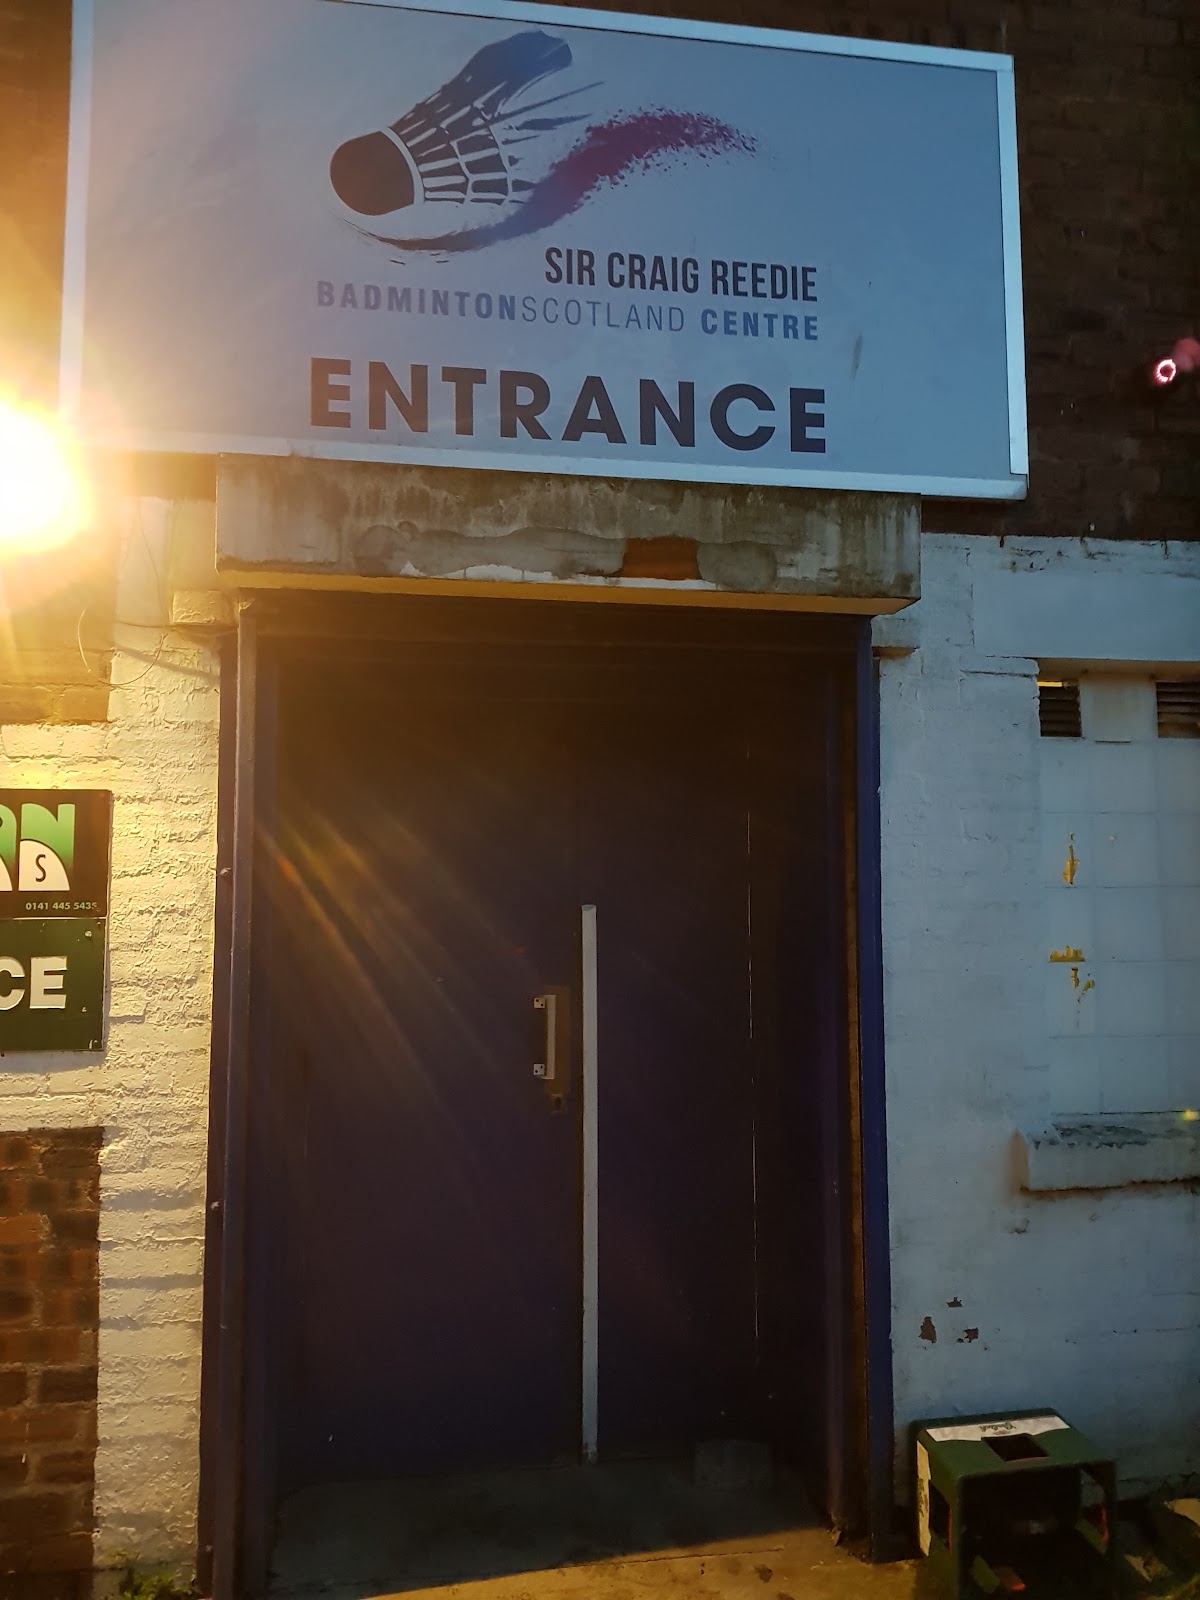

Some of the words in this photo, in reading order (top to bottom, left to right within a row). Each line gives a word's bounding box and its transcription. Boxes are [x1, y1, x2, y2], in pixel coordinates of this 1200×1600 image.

[544, 246, 596, 287] SIR
[607, 252, 700, 293] CRAIG
[711, 259, 819, 303] REEDIE
[701, 308, 820, 341] CENTRE
[310, 357, 827, 454] ENTRANCE
[25, 901, 49, 911] 0141
[52, 901, 71, 910] 445
